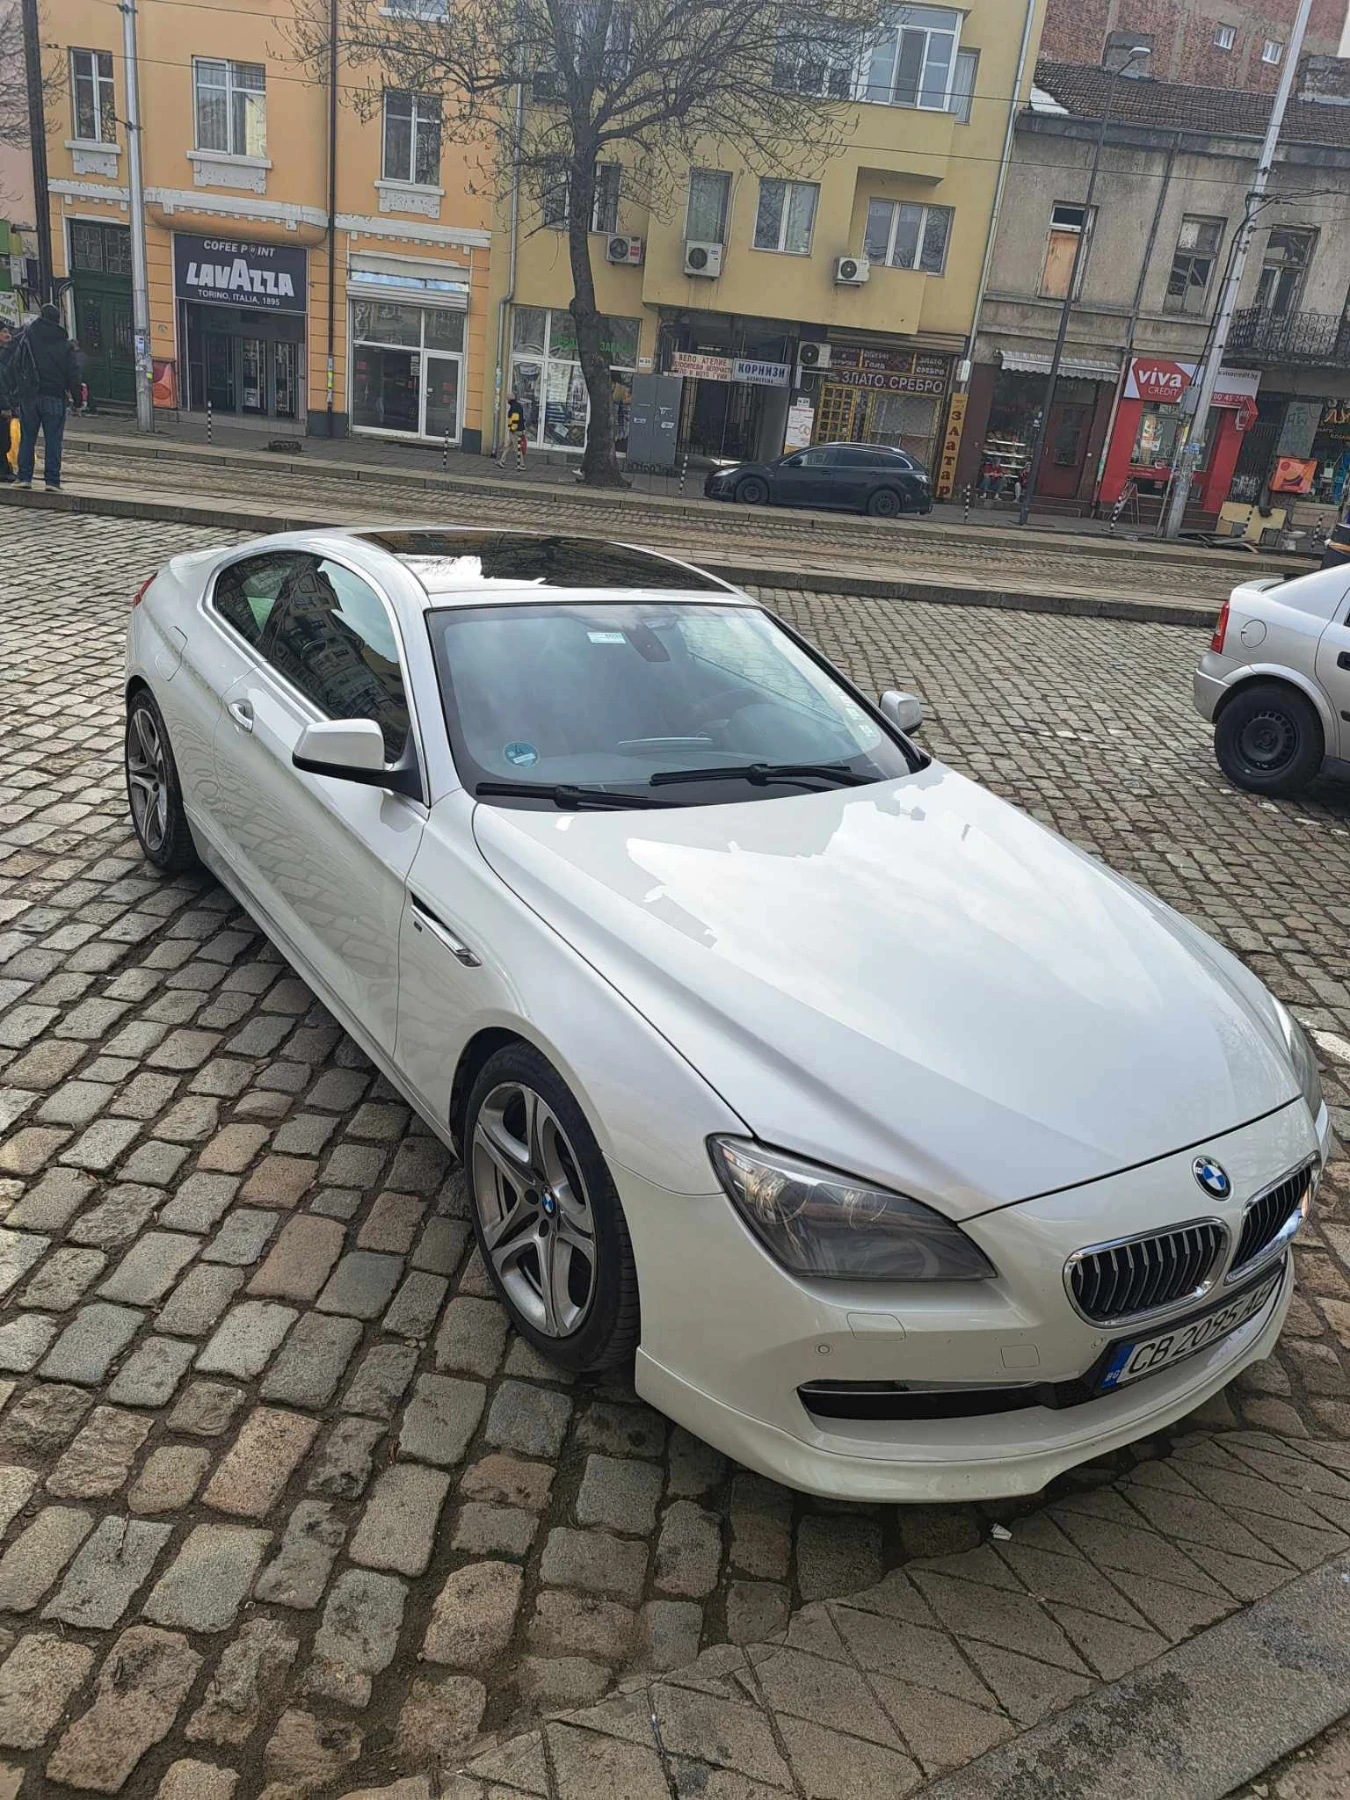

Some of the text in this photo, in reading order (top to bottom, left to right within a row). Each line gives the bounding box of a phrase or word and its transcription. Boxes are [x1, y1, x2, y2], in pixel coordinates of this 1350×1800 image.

[204, 240, 238, 253] COFEE
[186, 258, 295, 297] LAVAZZA
[198, 289, 280, 306] TORINO, ITALIA, 1895
[738, 362, 786, 378] КОРНИЗИ
[1138, 367, 1182, 388] viva
[889, 376, 943, 393] СРЕБРО
[1147, 385, 1179, 397] CREDIT
[1128, 1335, 1175, 1374] CB
[1171, 1300, 1244, 1358] 2095
